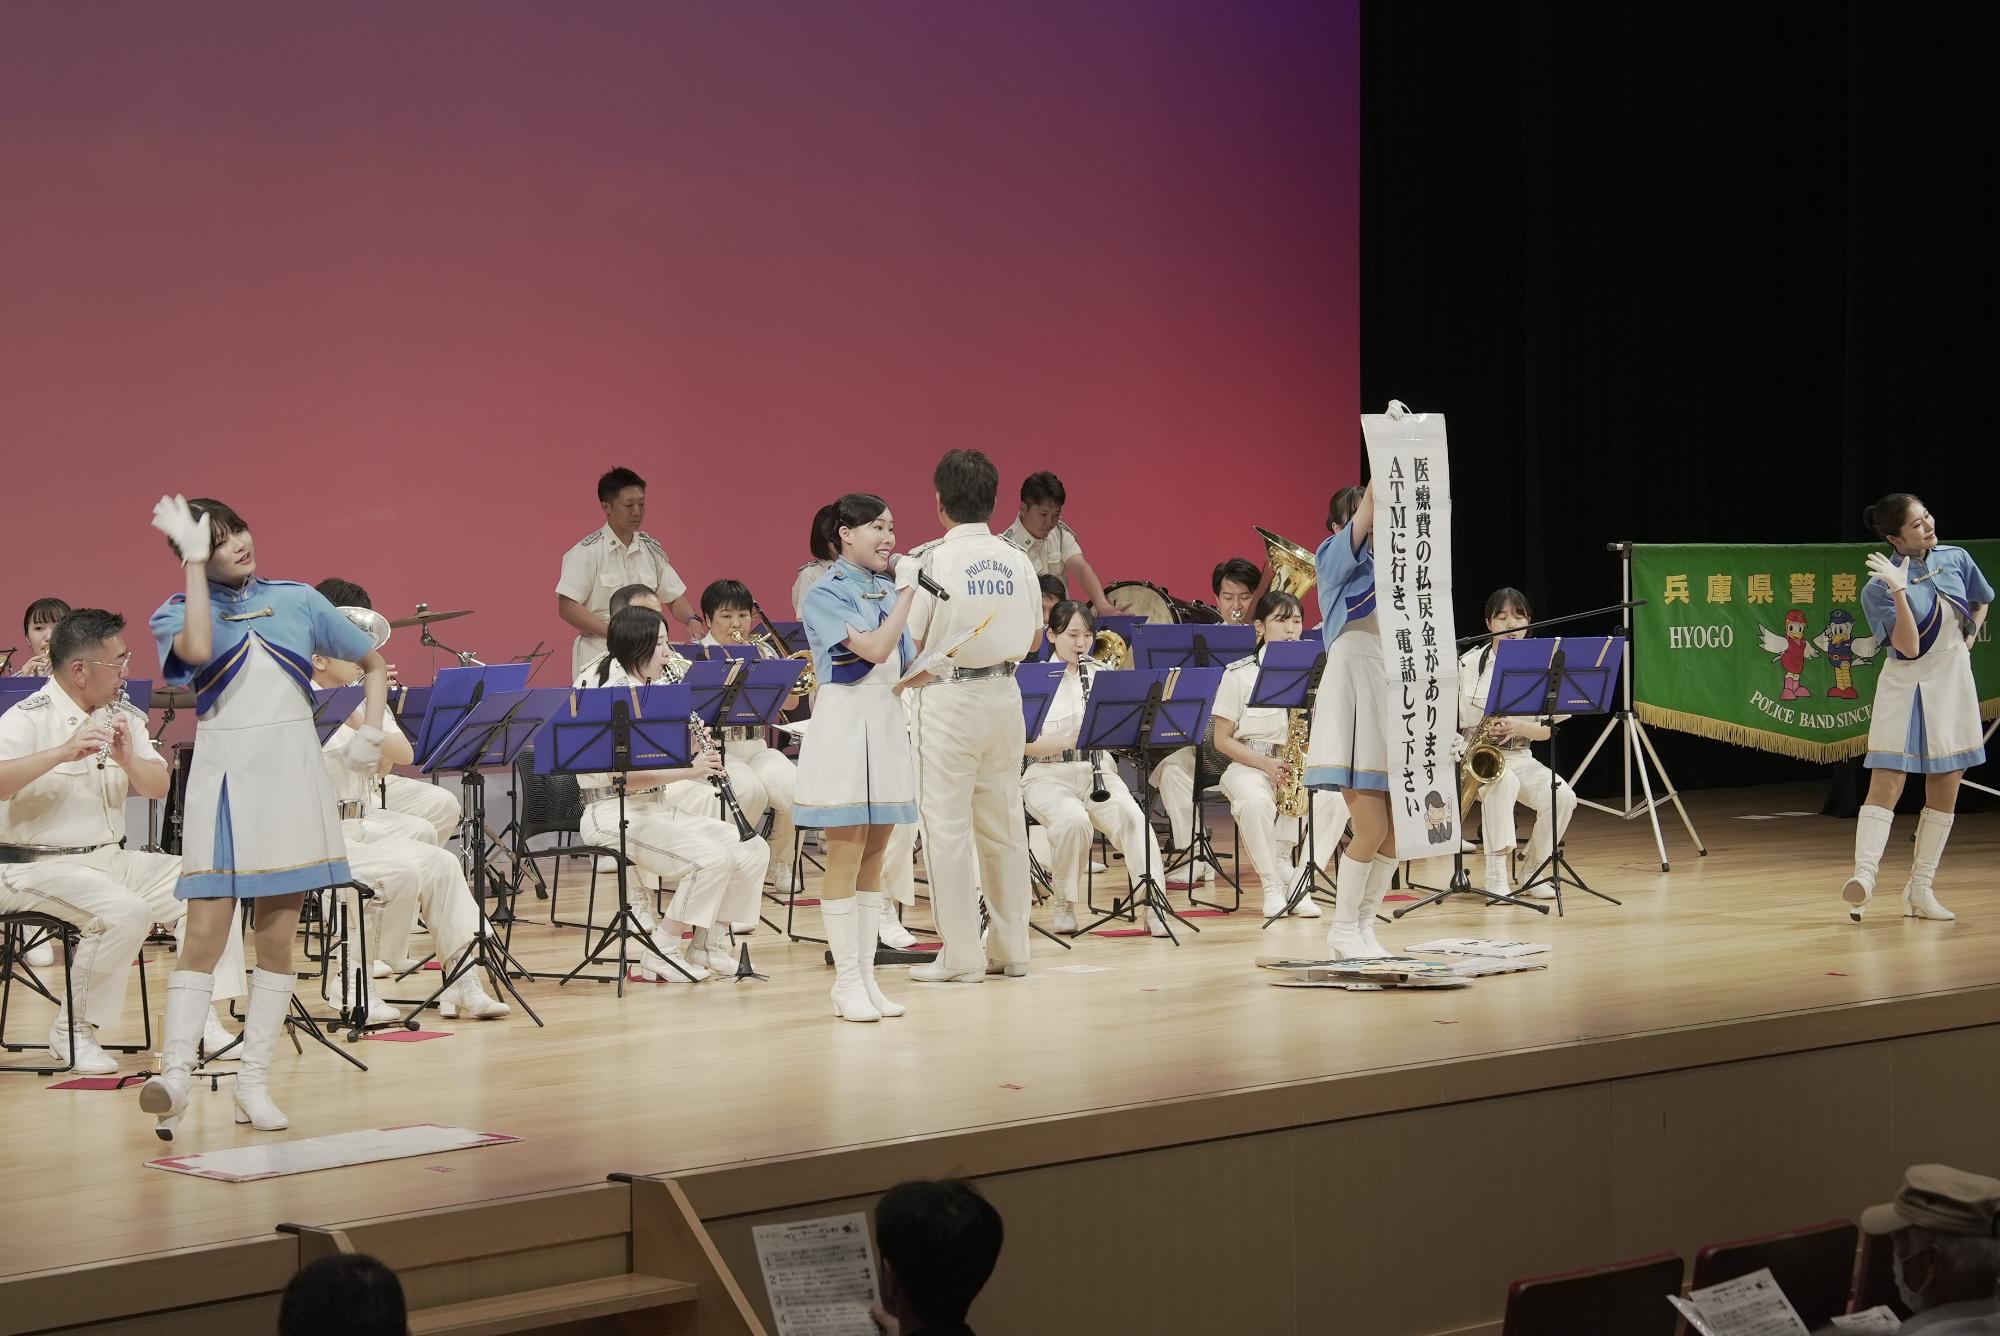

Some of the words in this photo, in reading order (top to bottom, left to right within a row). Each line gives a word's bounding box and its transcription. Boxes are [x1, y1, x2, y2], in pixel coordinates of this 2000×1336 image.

[965, 560, 991, 578] POLICE
[992, 560, 1013, 579] BAND
[967, 580, 1014, 595] HYOGO
[1663, 572, 1857, 605] 兵庫県警察
[1389, 456, 1420, 817] ATMに行き、電話して下さい
[1413, 456, 1439, 785] 医療費の払戻金があります
[1668, 625, 1734, 649] HYOGO
[1749, 690, 1795, 724] POLICE
[1799, 711, 1835, 729] BAND
[1836, 703, 1873, 728] SINCE
